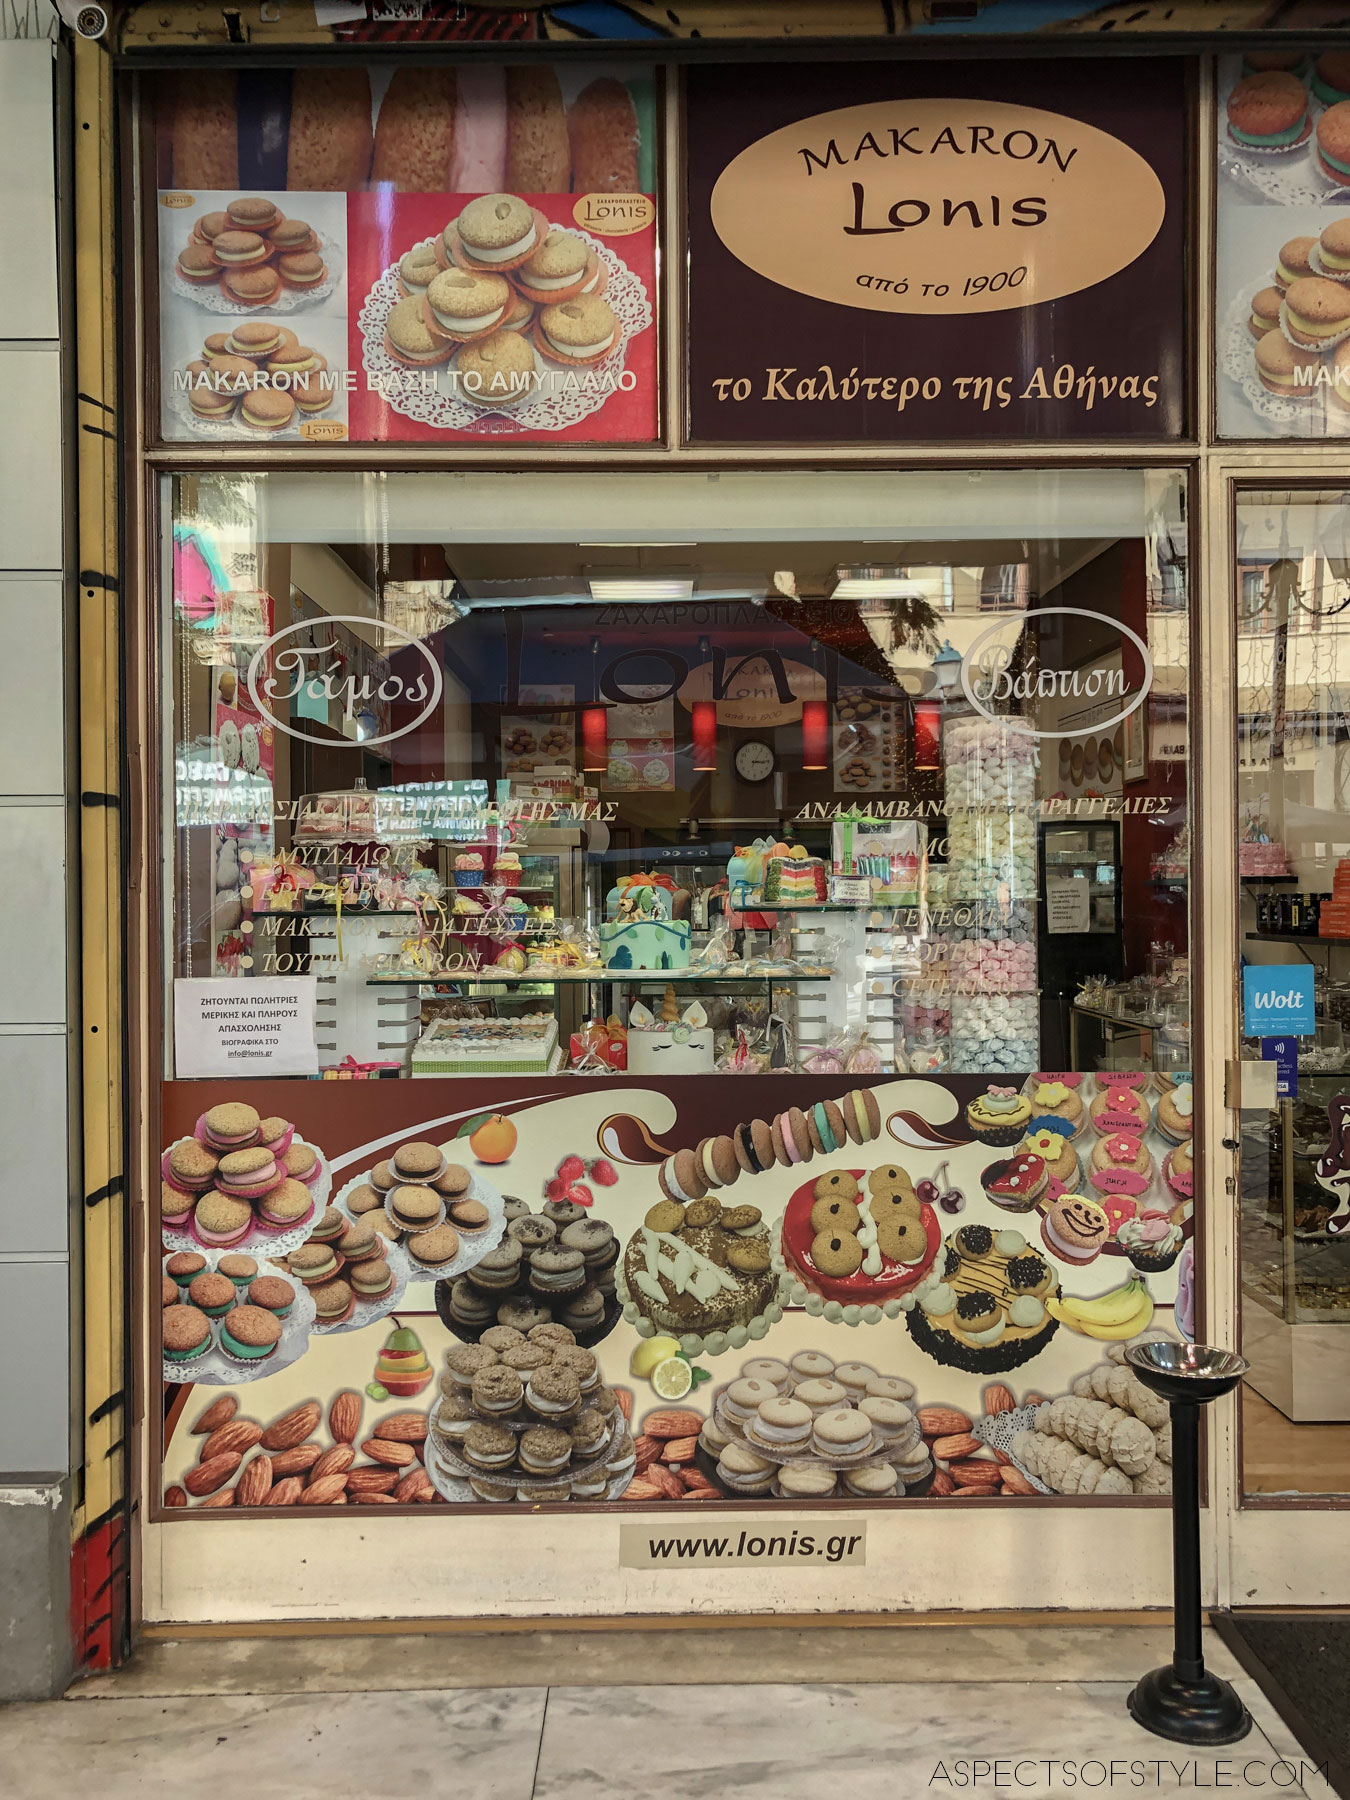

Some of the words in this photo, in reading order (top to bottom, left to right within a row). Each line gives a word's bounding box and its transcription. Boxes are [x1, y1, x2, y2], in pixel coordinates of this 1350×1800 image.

[798, 126, 1078, 176] MAKARON
[583, 200, 647, 221] Lonis
[843, 182, 1048, 235] Lonis
[856, 274, 909, 294] από
[921, 284, 949, 297] το
[963, 266, 1028, 296] 1900
[489, 370, 637, 391] ΑΜΥΓΔΑΛΟ
[712, 378, 752, 401] το
[762, 368, 941, 411] Καλύτερο
[952, 376, 1012, 411] της
[1019, 364, 1159, 411] Αθήνας
[564, 801, 620, 821] ΜΑΣ
[432, 917, 456, 936] 14
[200, 997, 249, 1006] ΖΗΤΟΥΝΤΑΙ
[250, 995, 299, 1005] ΠΩΛΗΤΡΙΕΣ
[1254, 990, 1304, 1010] Wolt
[201, 1011, 240, 1020] ΜΕΡΙΚΗΣ
[241, 1010, 256, 1019] ΚΑΙ
[257, 1009, 298, 1018] ΠΛΗΡΟΥΣ
[218, 1023, 282, 1033] ΑΠΑΣΧΟΛΗΣΗΣ
[227, 1049, 273, 1058] info@lonis.gr
[649, 1530, 862, 1562] www.lonis.gr
